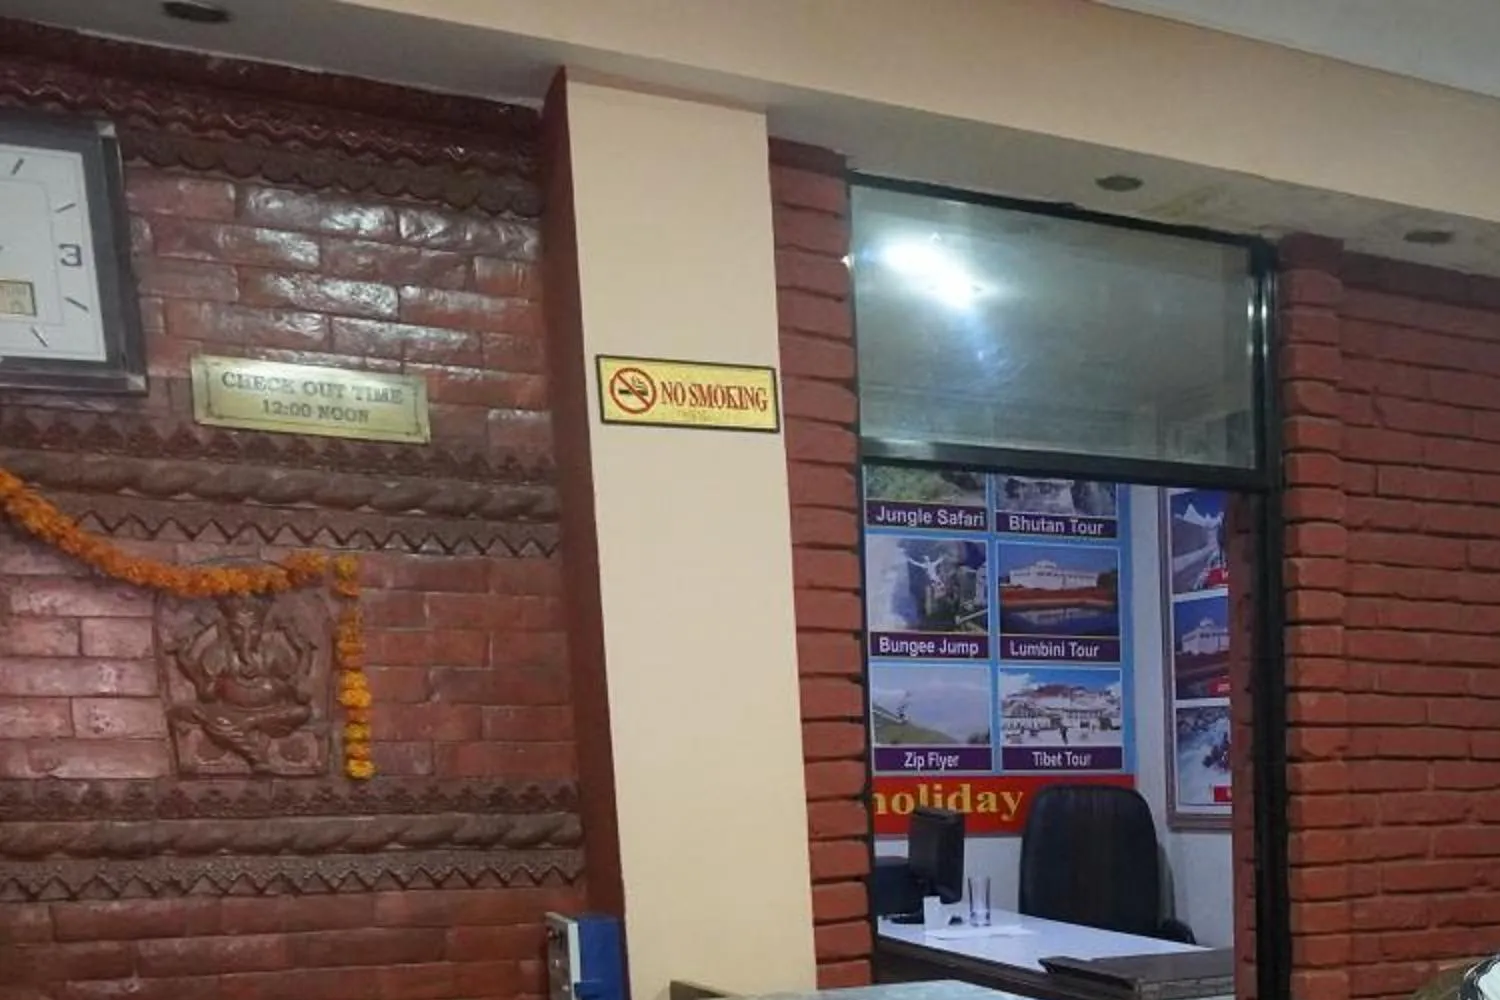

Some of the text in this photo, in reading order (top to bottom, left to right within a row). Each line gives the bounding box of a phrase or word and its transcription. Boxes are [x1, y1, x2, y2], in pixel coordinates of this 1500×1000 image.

[58, 243, 82, 267] 3
[221, 371, 404, 405] CHECK OUT TIME
[660, 381, 768, 413] NO SMOKING
[262, 399, 371, 424] 12:00 NOON
[876, 505, 985, 527] Jungle Safari
[1009, 515, 1105, 535] Bhutan Tour
[879, 636, 979, 657] Bungee Jump
[1009, 640, 1100, 657] Lumbini Tour
[904, 751, 960, 772] Zip Flyer
[1032, 751, 1093, 767] Tibet Tour
